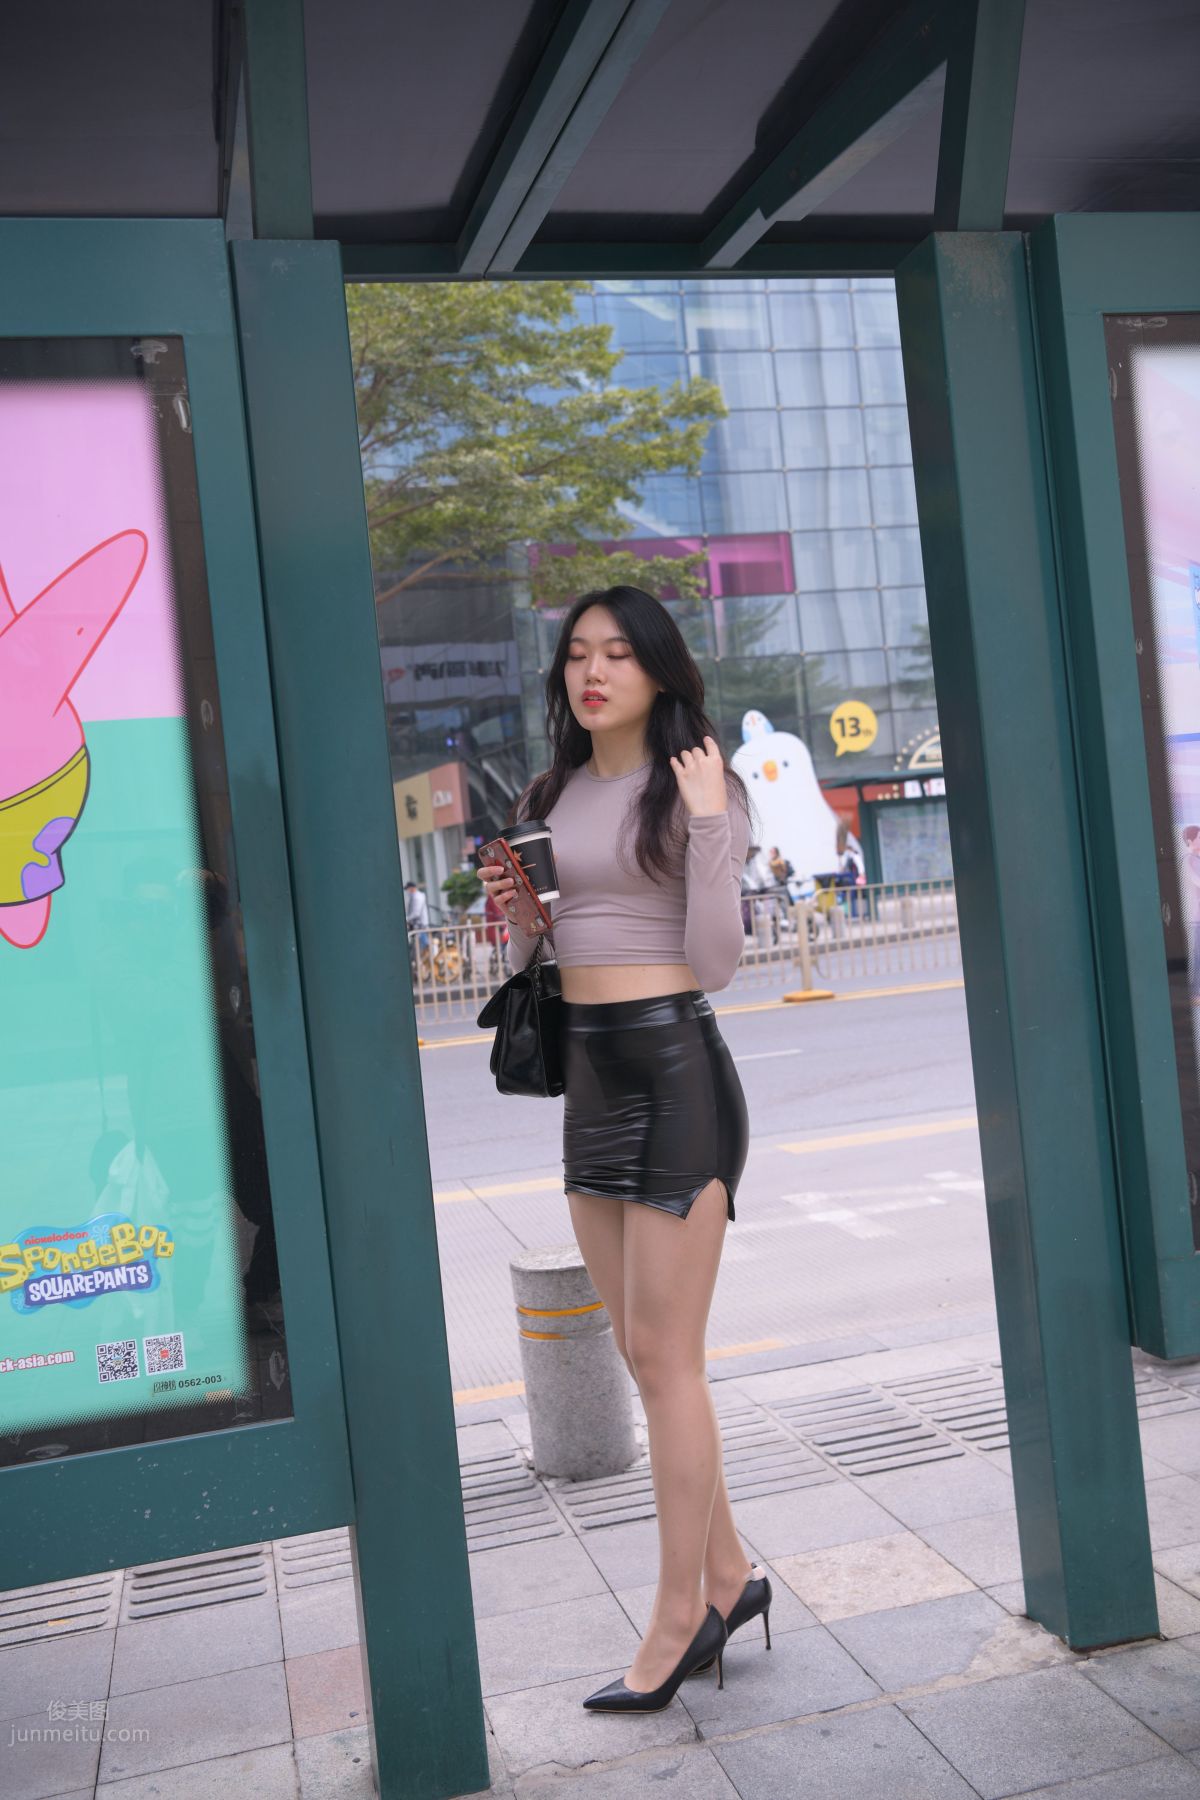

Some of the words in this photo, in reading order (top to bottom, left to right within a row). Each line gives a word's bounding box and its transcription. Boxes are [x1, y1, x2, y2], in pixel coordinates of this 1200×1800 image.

[24, 1232, 89, 1245] nickelodeon
[28, 1265, 149, 1302] SQUAREPANTS
[178, 1374, 223, 1389] 0562-003
